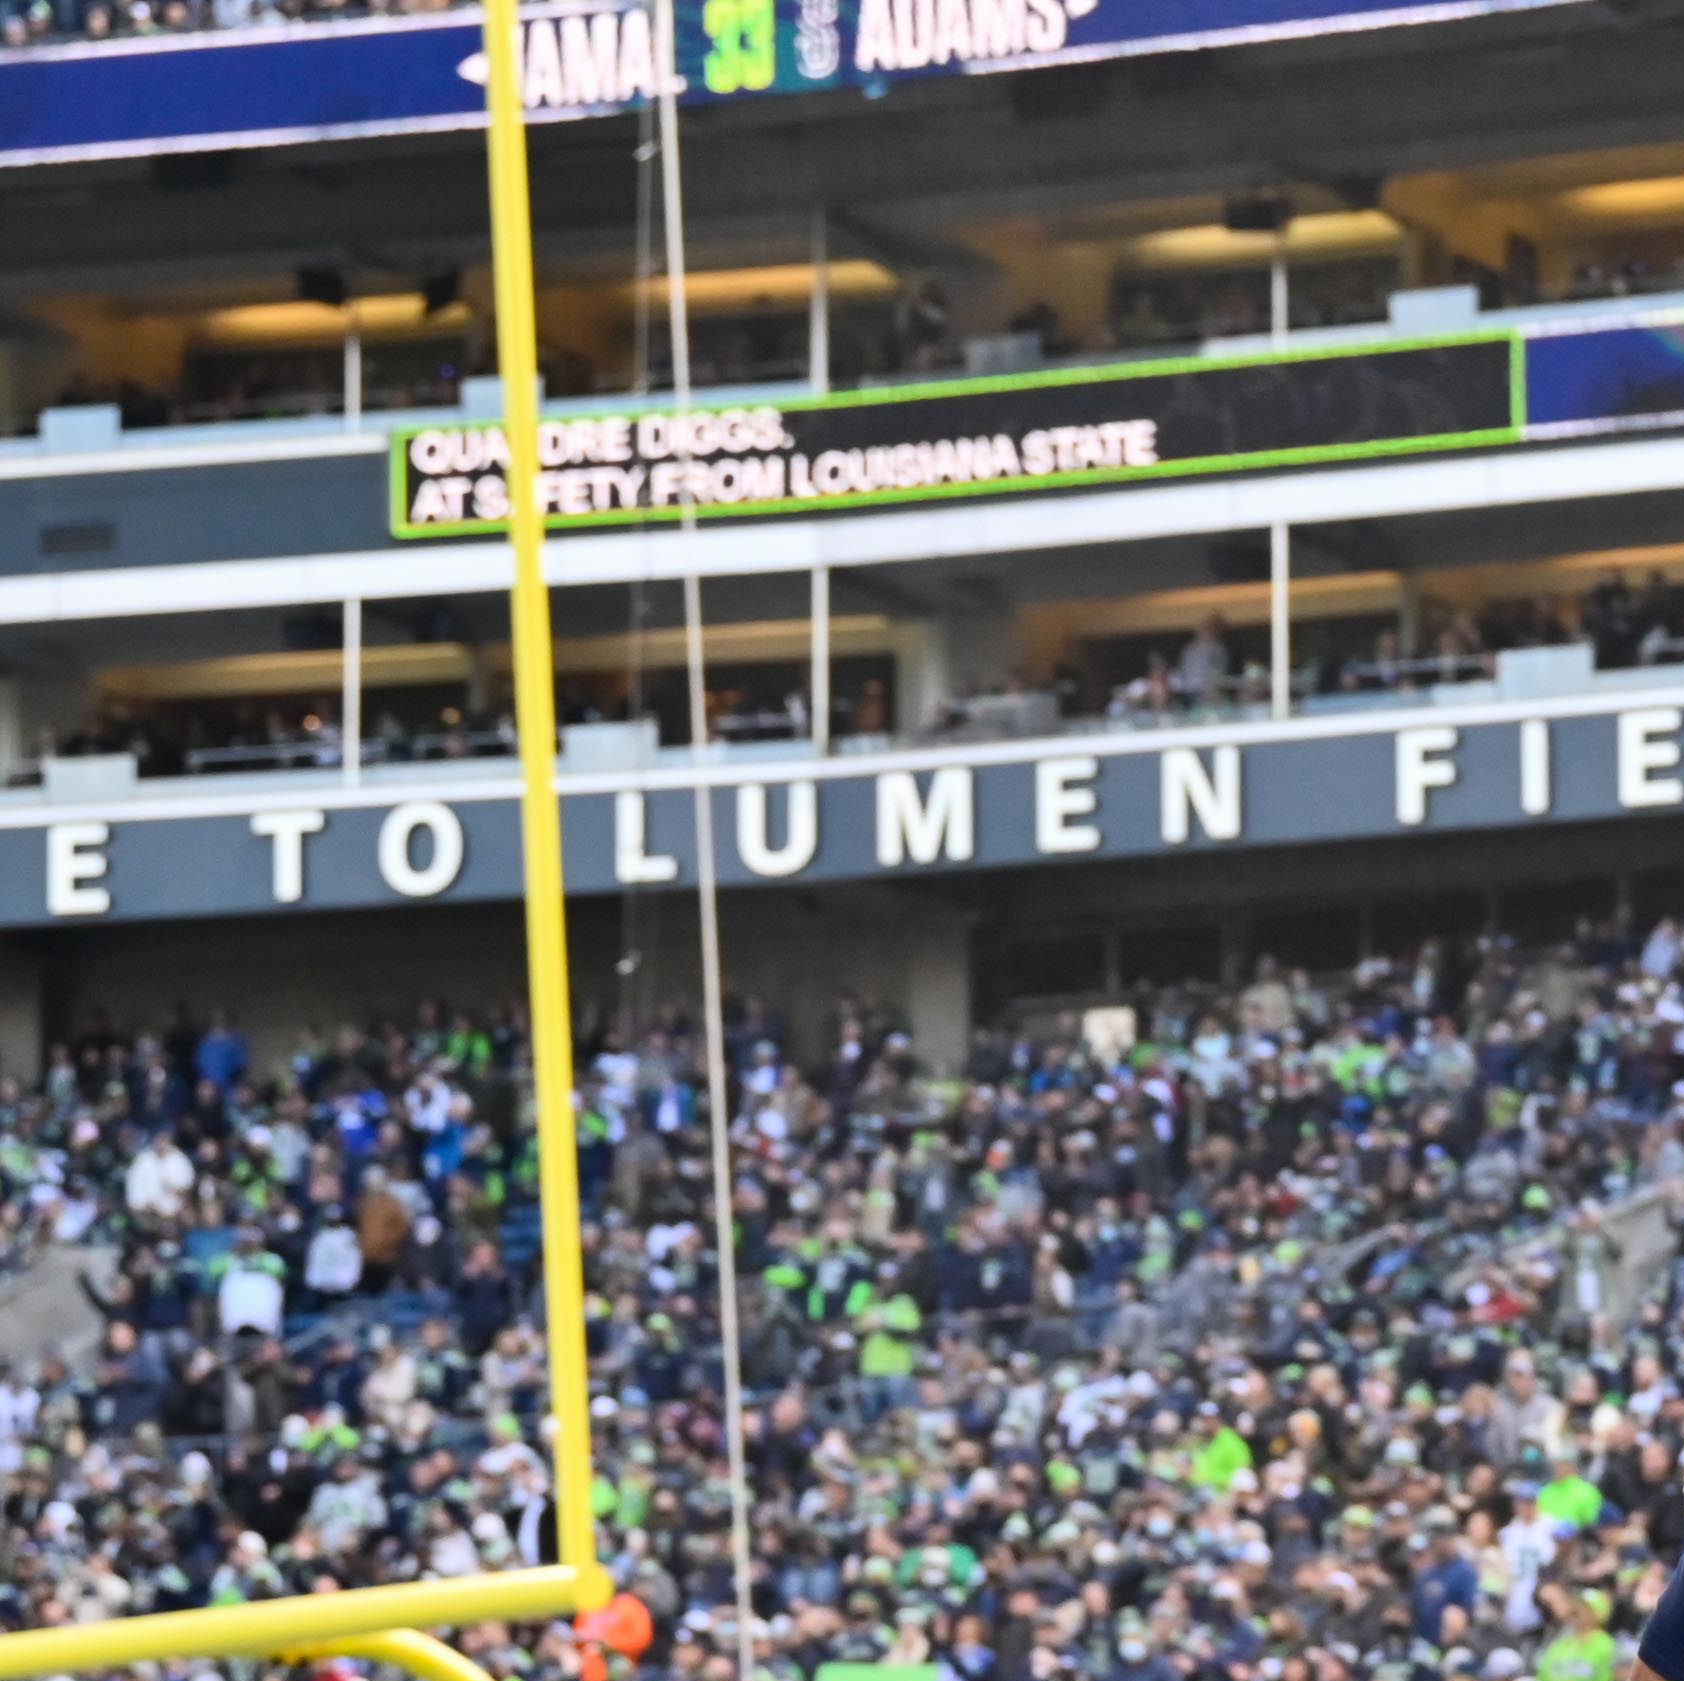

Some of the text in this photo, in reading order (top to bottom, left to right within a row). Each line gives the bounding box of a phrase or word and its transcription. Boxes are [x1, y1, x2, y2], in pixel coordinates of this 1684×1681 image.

[704, 0, 776, 93] 33
[410, 418, 632, 476] QUADRE
[410, 418, 1158, 524] AT SFETY FROM LOUISIANA STATE
[250, 800, 465, 904] TO
[614, 743, 1243, 885] LUMEN
